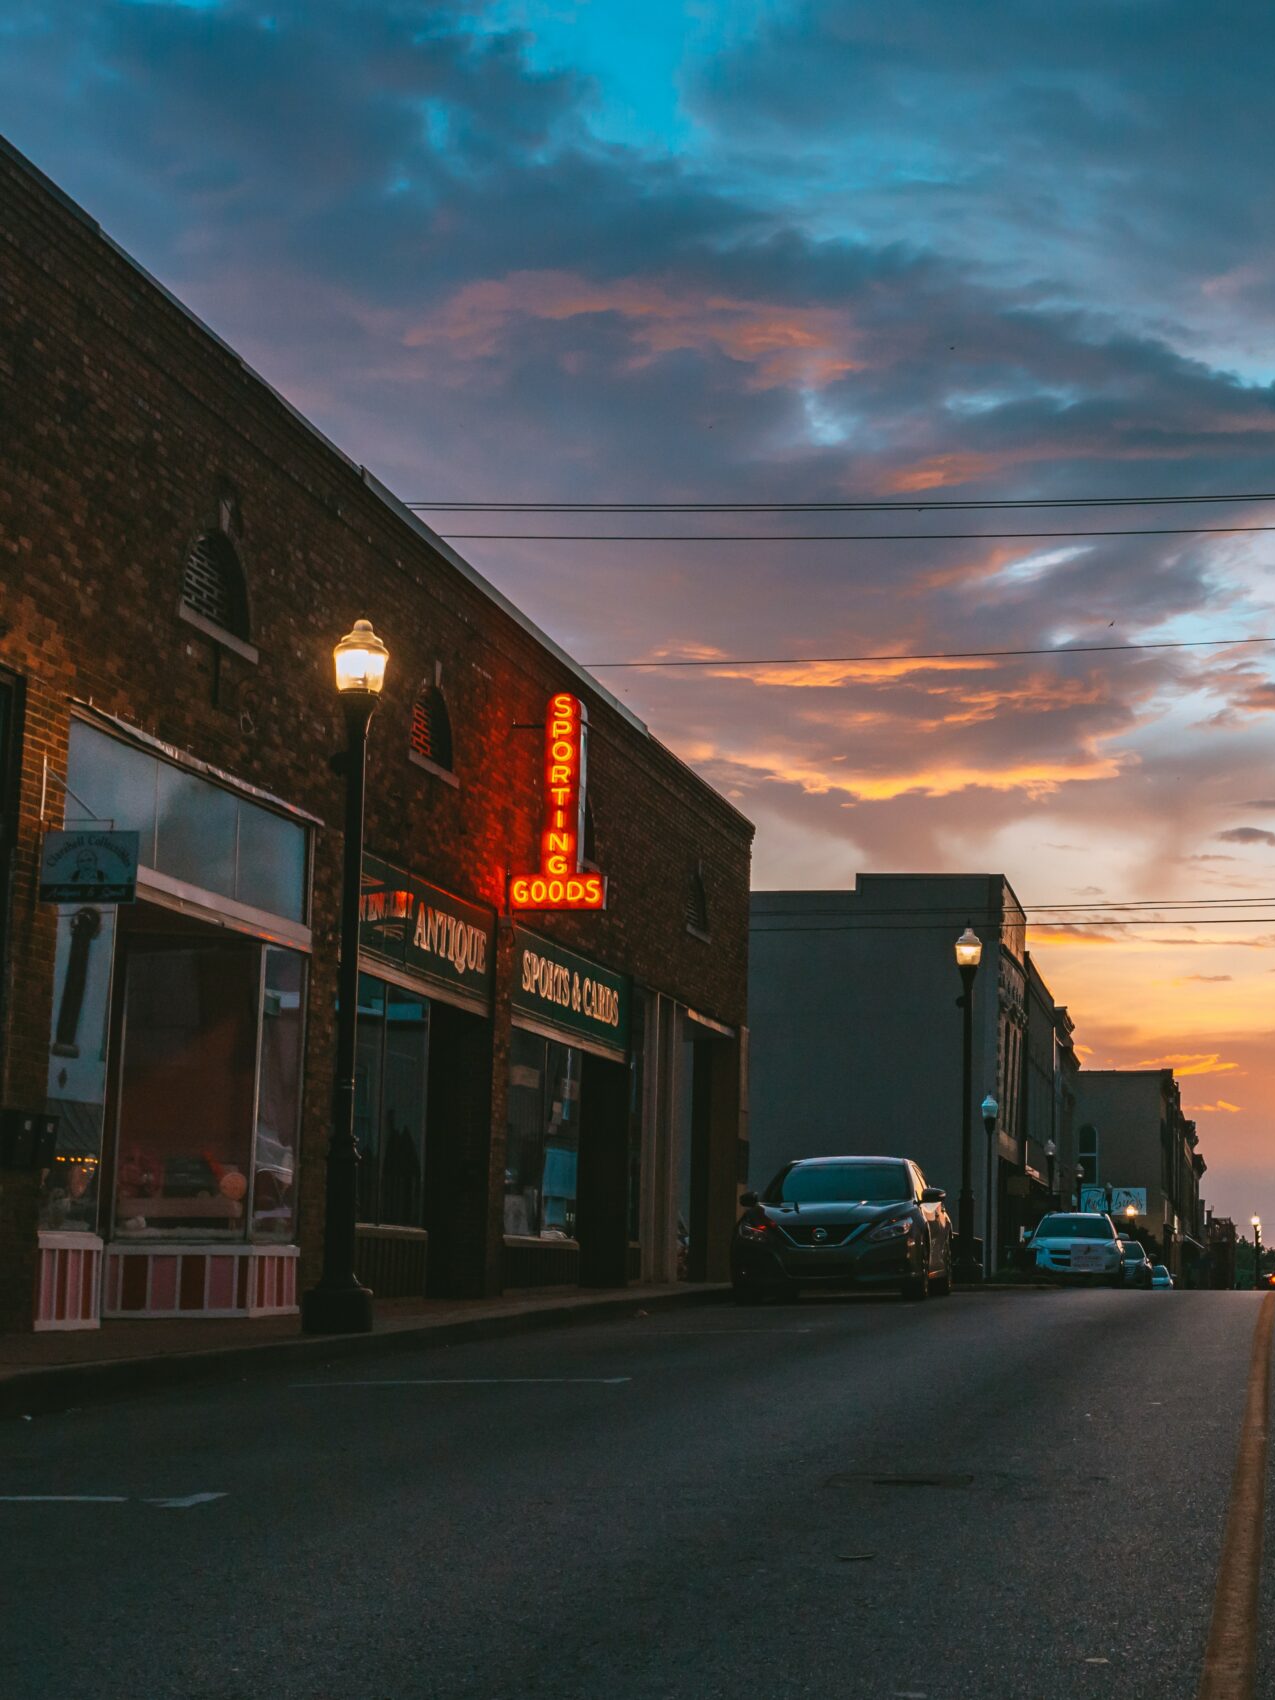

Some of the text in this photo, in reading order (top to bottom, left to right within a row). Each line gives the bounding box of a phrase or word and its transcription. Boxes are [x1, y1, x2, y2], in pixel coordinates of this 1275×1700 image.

[547, 696, 574, 875] SPORTING
[513, 880, 600, 904] GOODS
[414, 901, 487, 974] ANTIQUE
[522, 949, 620, 1027] SPORTS & CARDS
